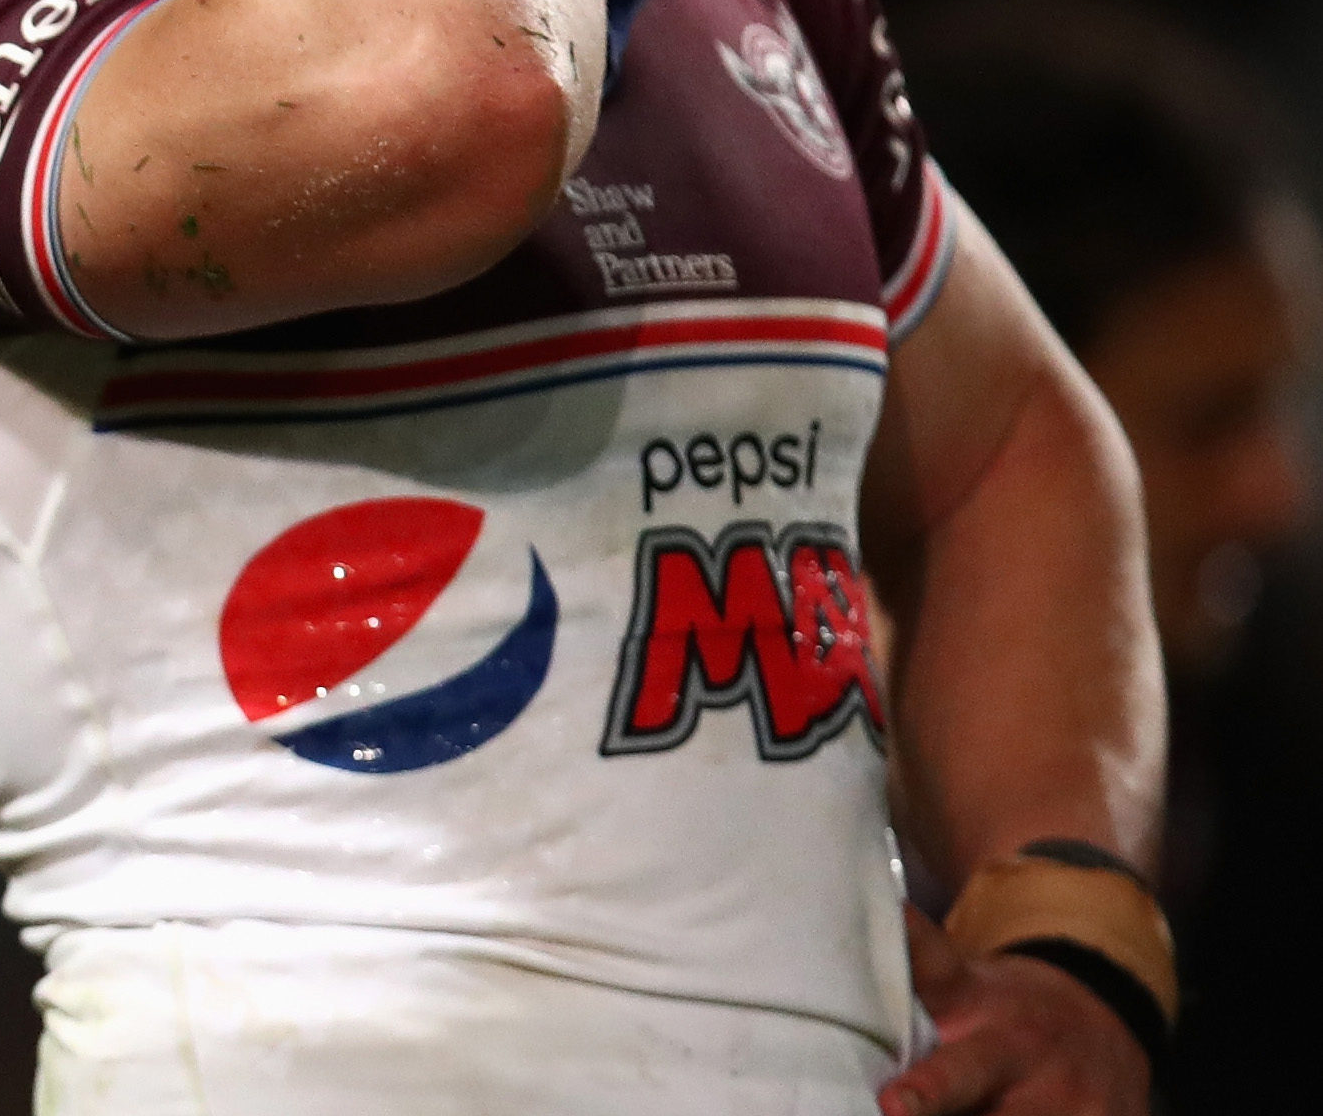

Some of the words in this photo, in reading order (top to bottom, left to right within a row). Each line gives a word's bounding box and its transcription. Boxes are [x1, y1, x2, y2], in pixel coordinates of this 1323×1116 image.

[583, 210, 646, 253] and
[593, 250, 738, 286] Partners
[641, 418, 823, 514] pepsi
